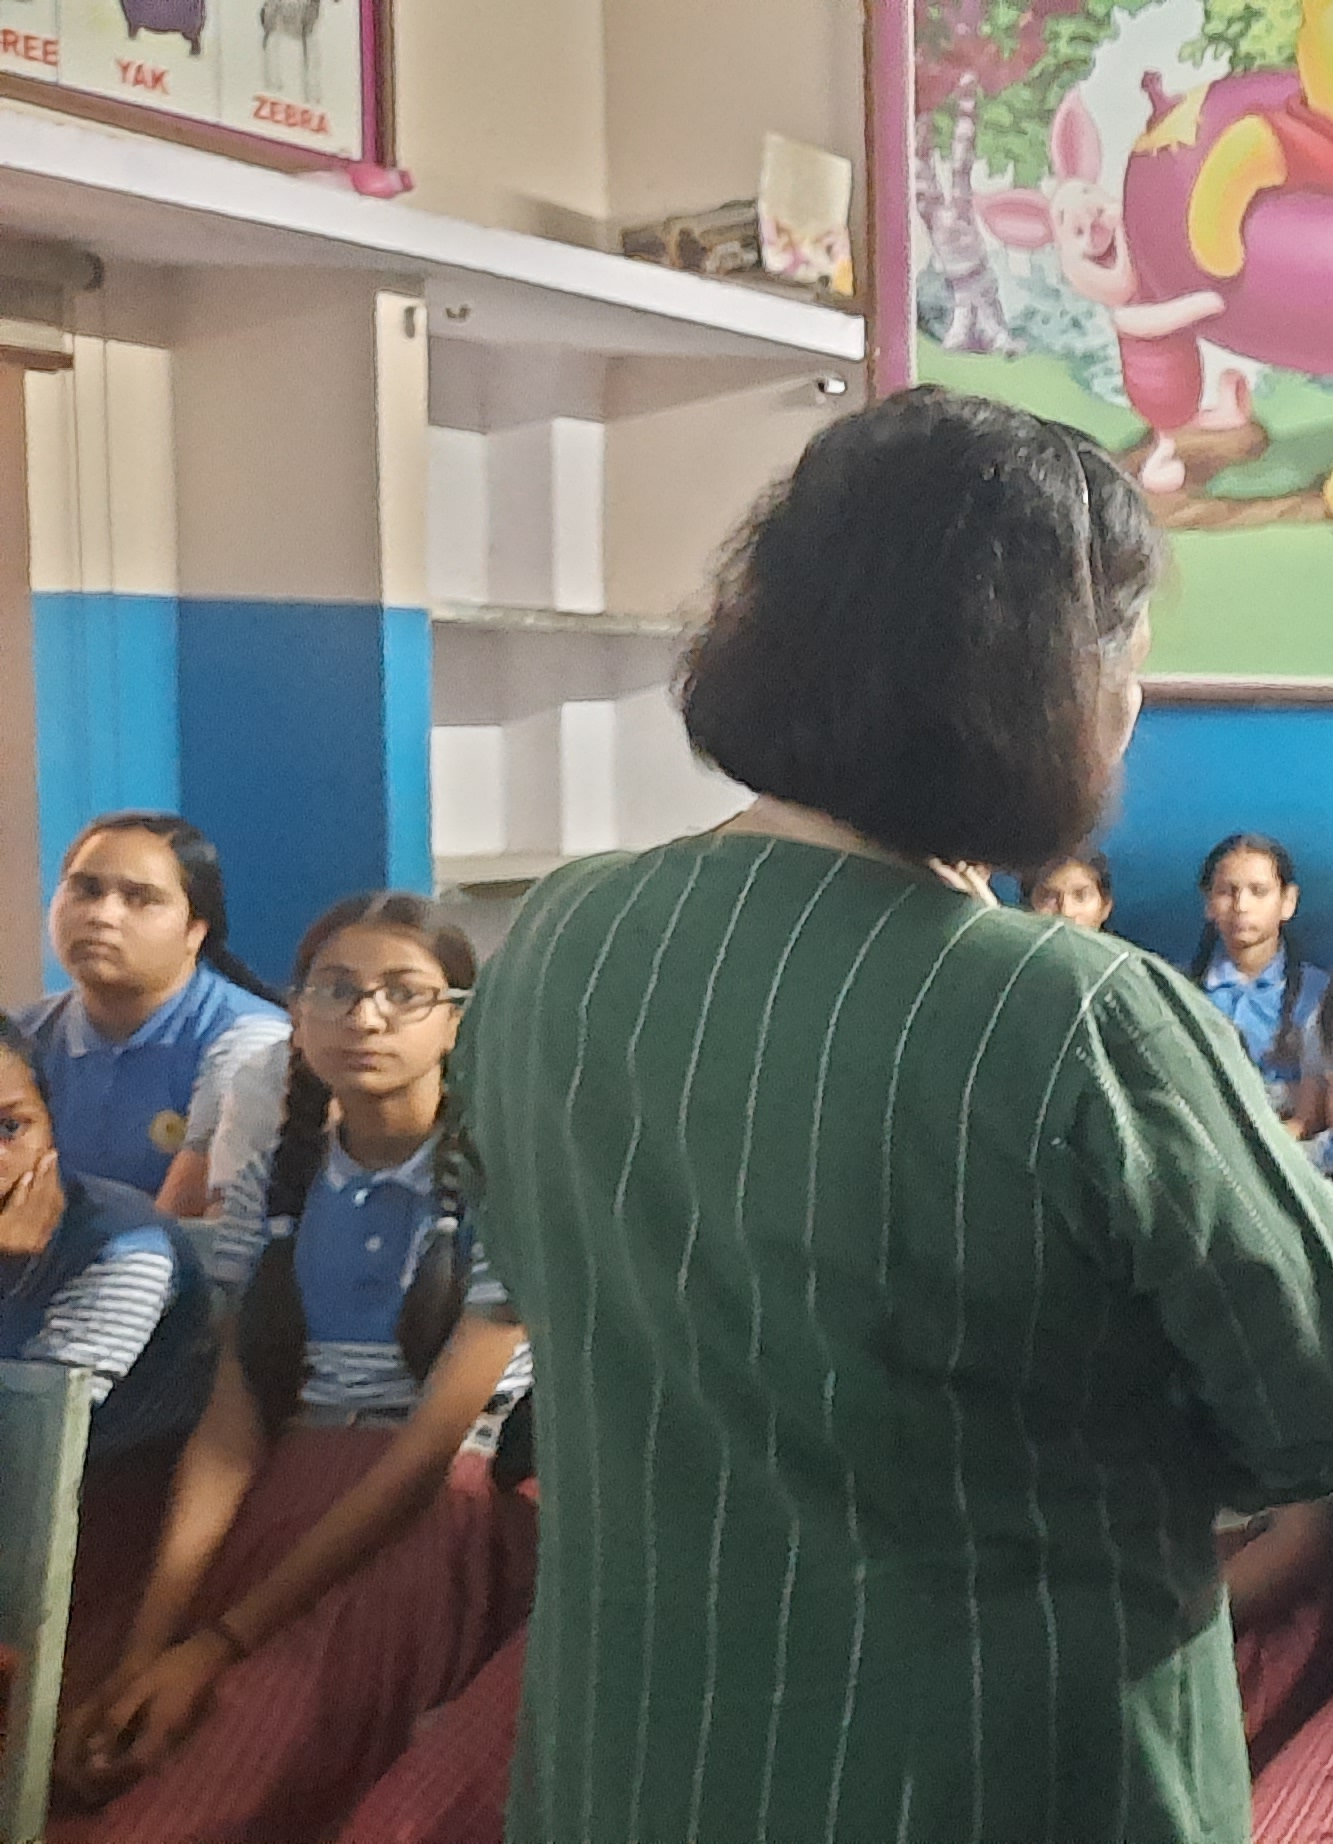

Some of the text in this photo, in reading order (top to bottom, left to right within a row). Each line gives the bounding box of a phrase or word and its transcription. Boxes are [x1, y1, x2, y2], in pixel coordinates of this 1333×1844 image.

[0, 28, 59, 66] REE
[117, 58, 170, 95] YAK
[253, 95, 331, 134] ZEBRA
